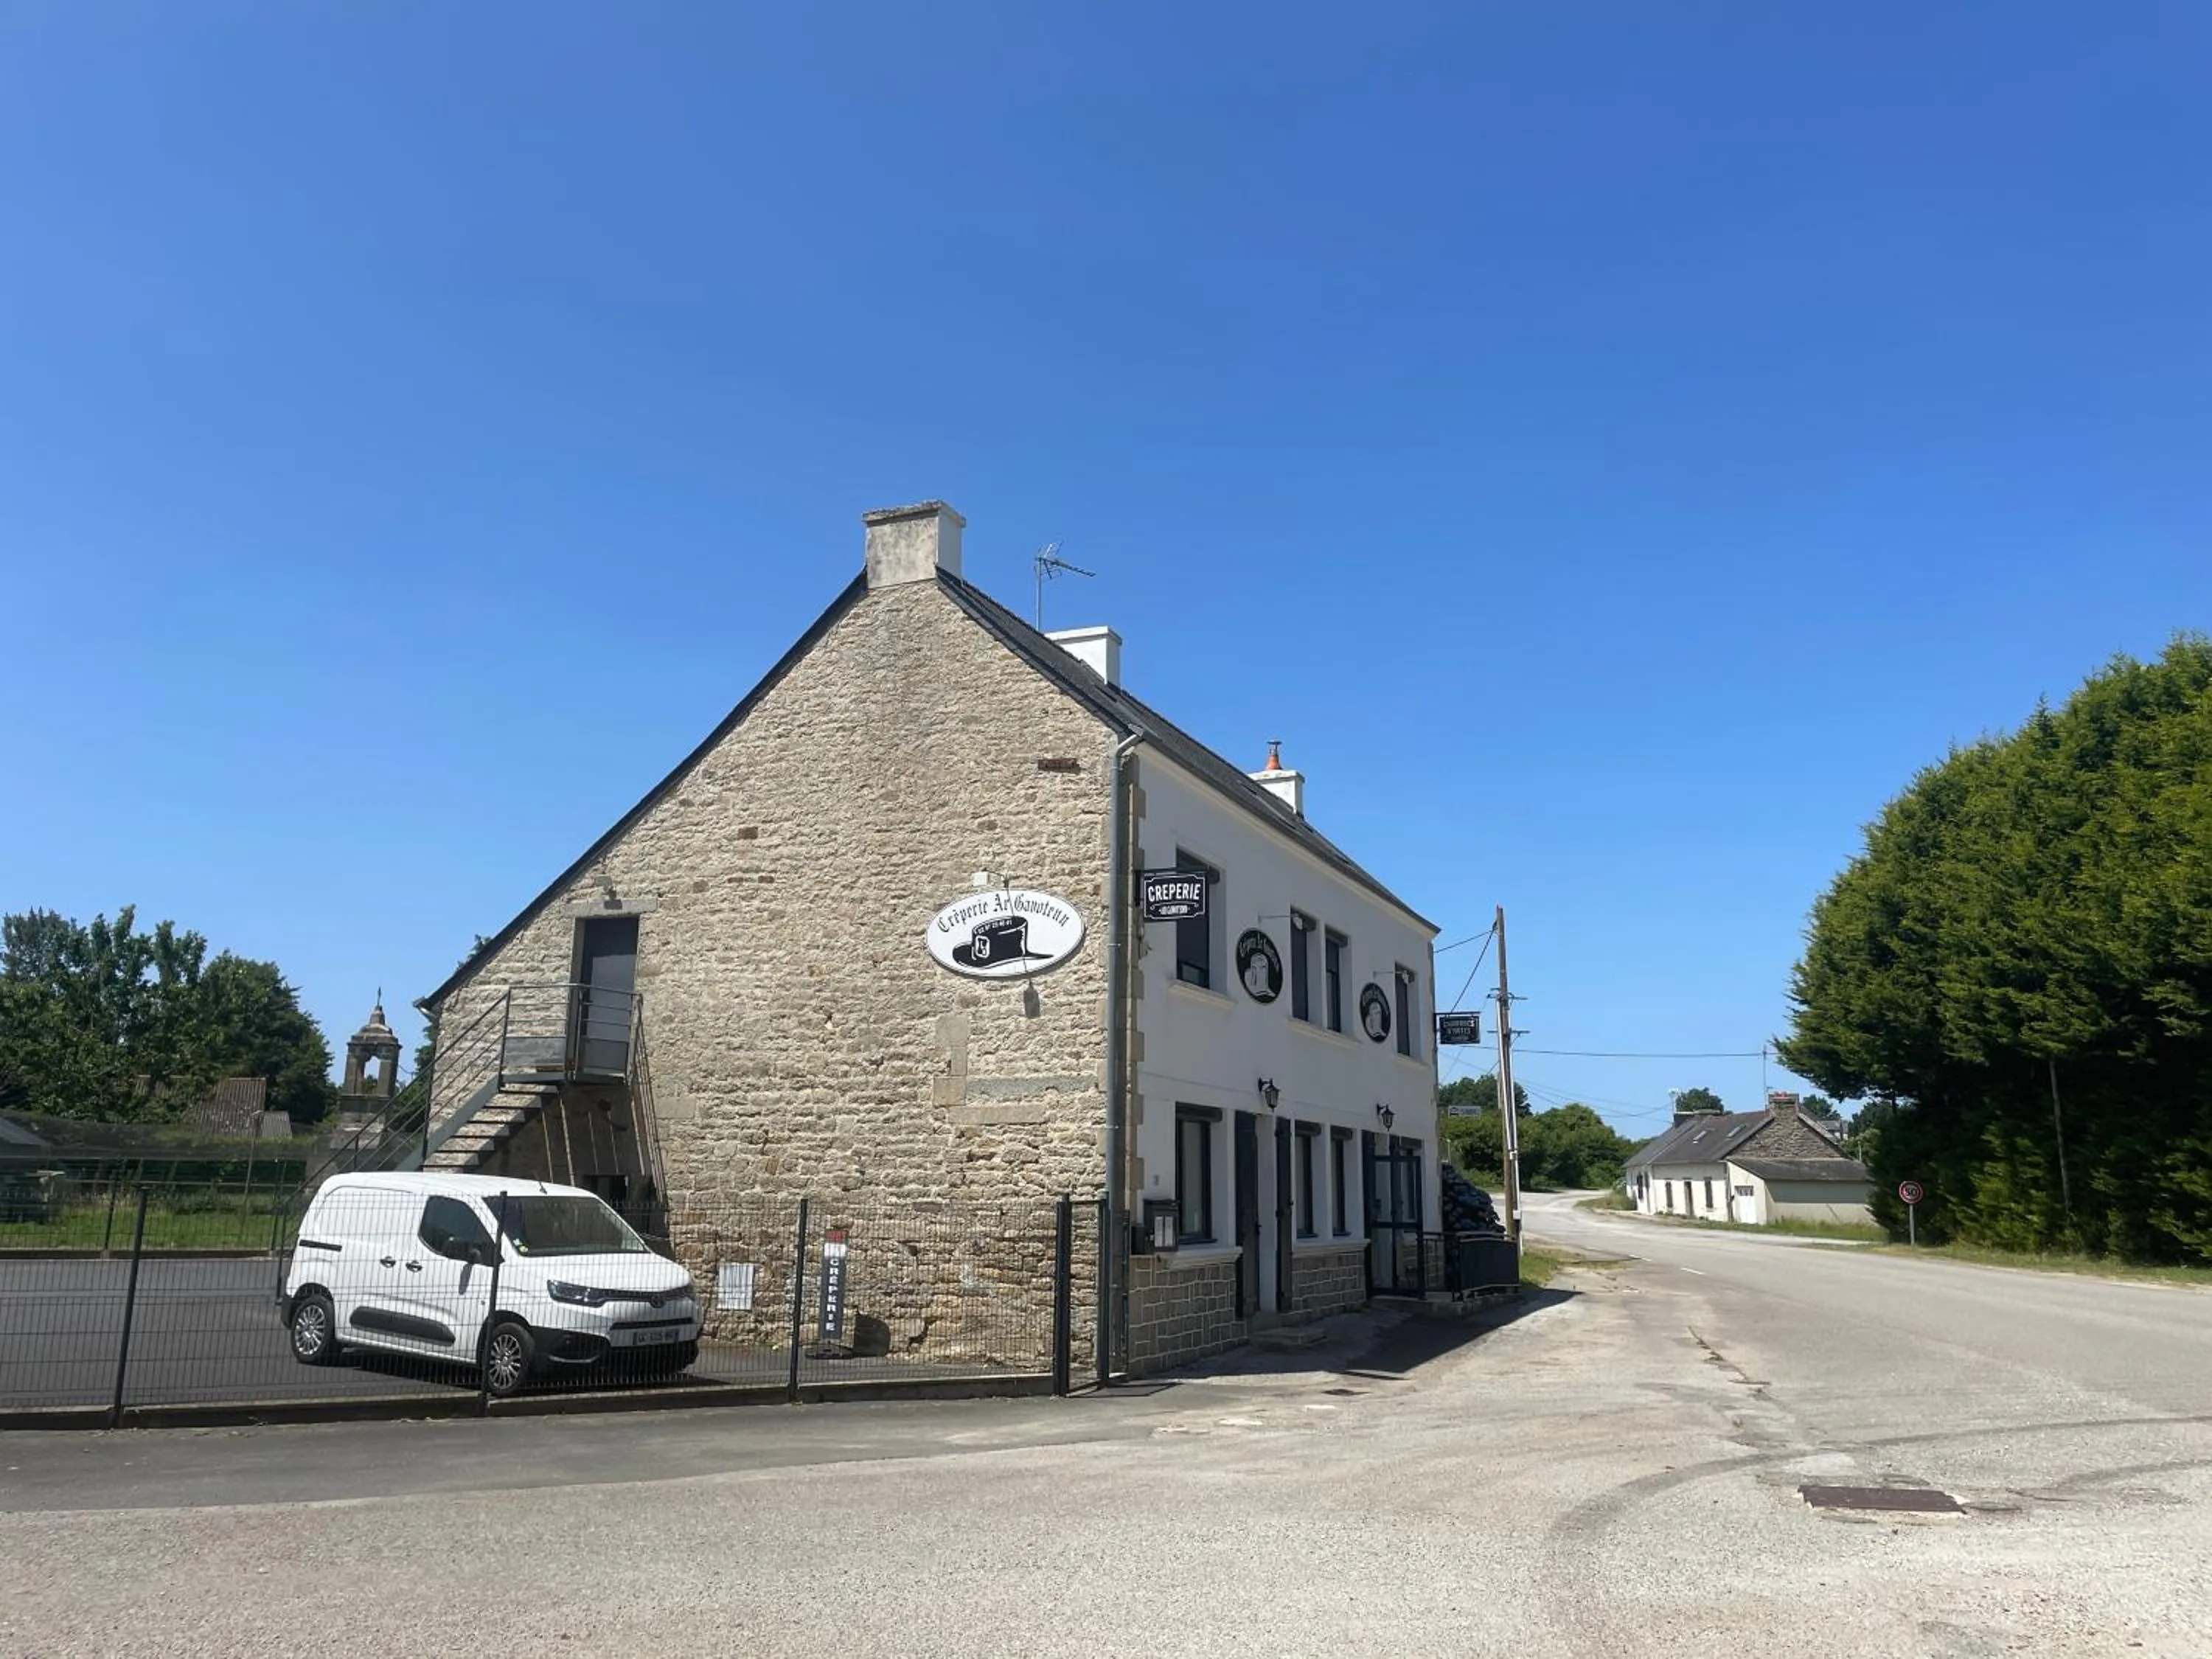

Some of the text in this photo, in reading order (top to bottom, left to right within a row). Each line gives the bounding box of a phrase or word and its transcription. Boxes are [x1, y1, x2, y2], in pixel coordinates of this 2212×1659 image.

[1147, 883, 1201, 902] CREPERIE
[937, 901, 989, 933] Crêperie
[825, 1258, 840, 1331] CREPERIE
